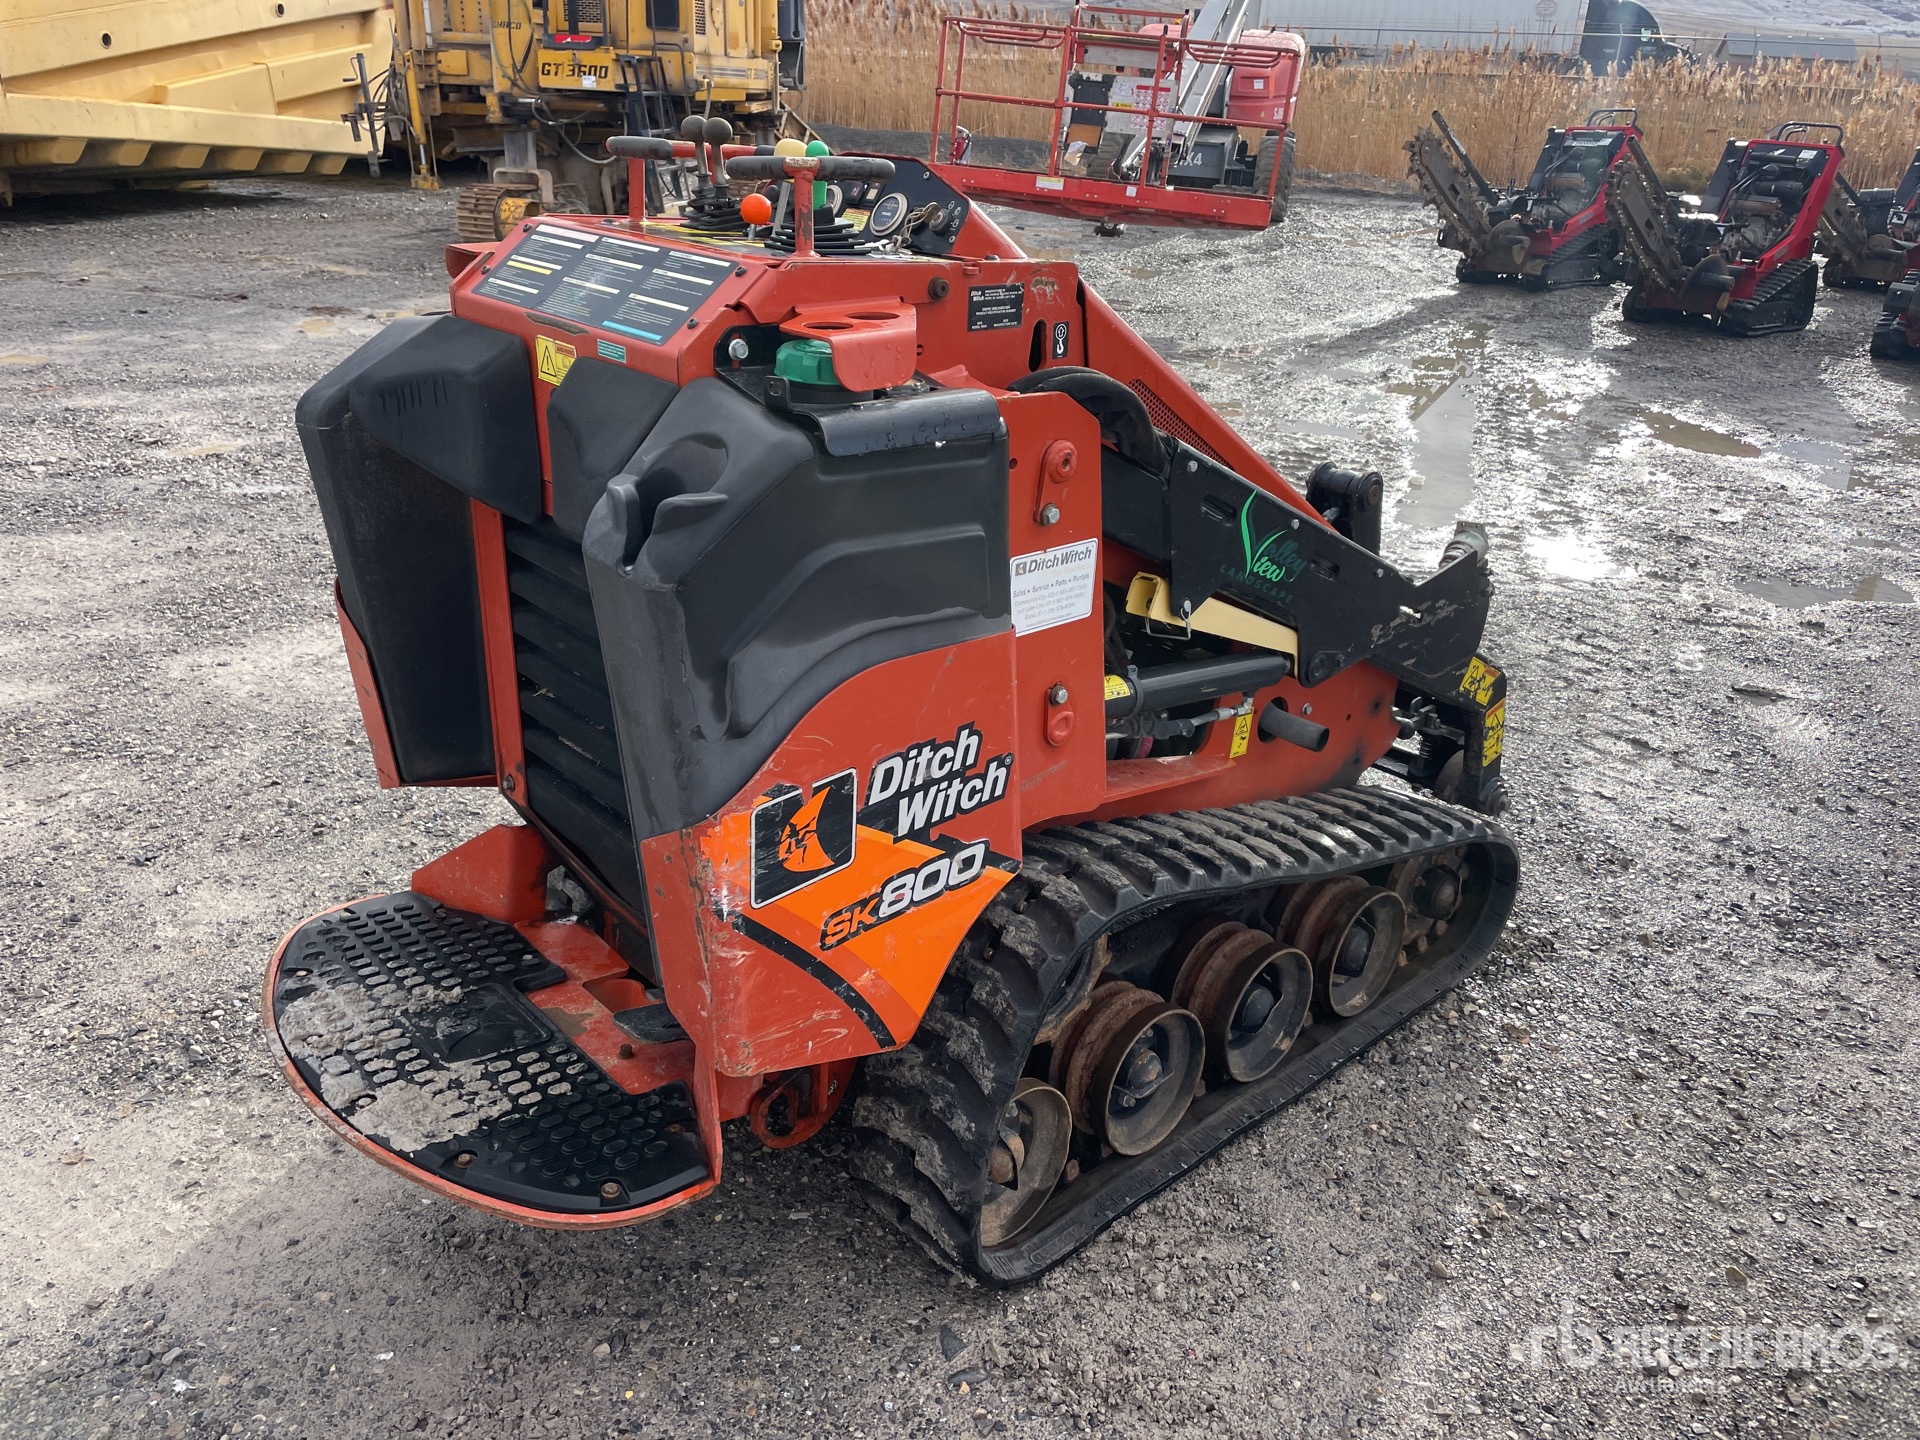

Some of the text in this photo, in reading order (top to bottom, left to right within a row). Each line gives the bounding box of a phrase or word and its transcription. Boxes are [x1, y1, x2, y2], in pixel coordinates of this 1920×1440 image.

[541, 62, 609, 79] GT 3600
[1013, 573, 1090, 598] Sales Service Parts Rentals
[1220, 563, 1294, 603] LANDSCAPE
[868, 728, 979, 806] Ditch
[897, 760, 1008, 837] Witch
[824, 842, 986, 945] SK800
